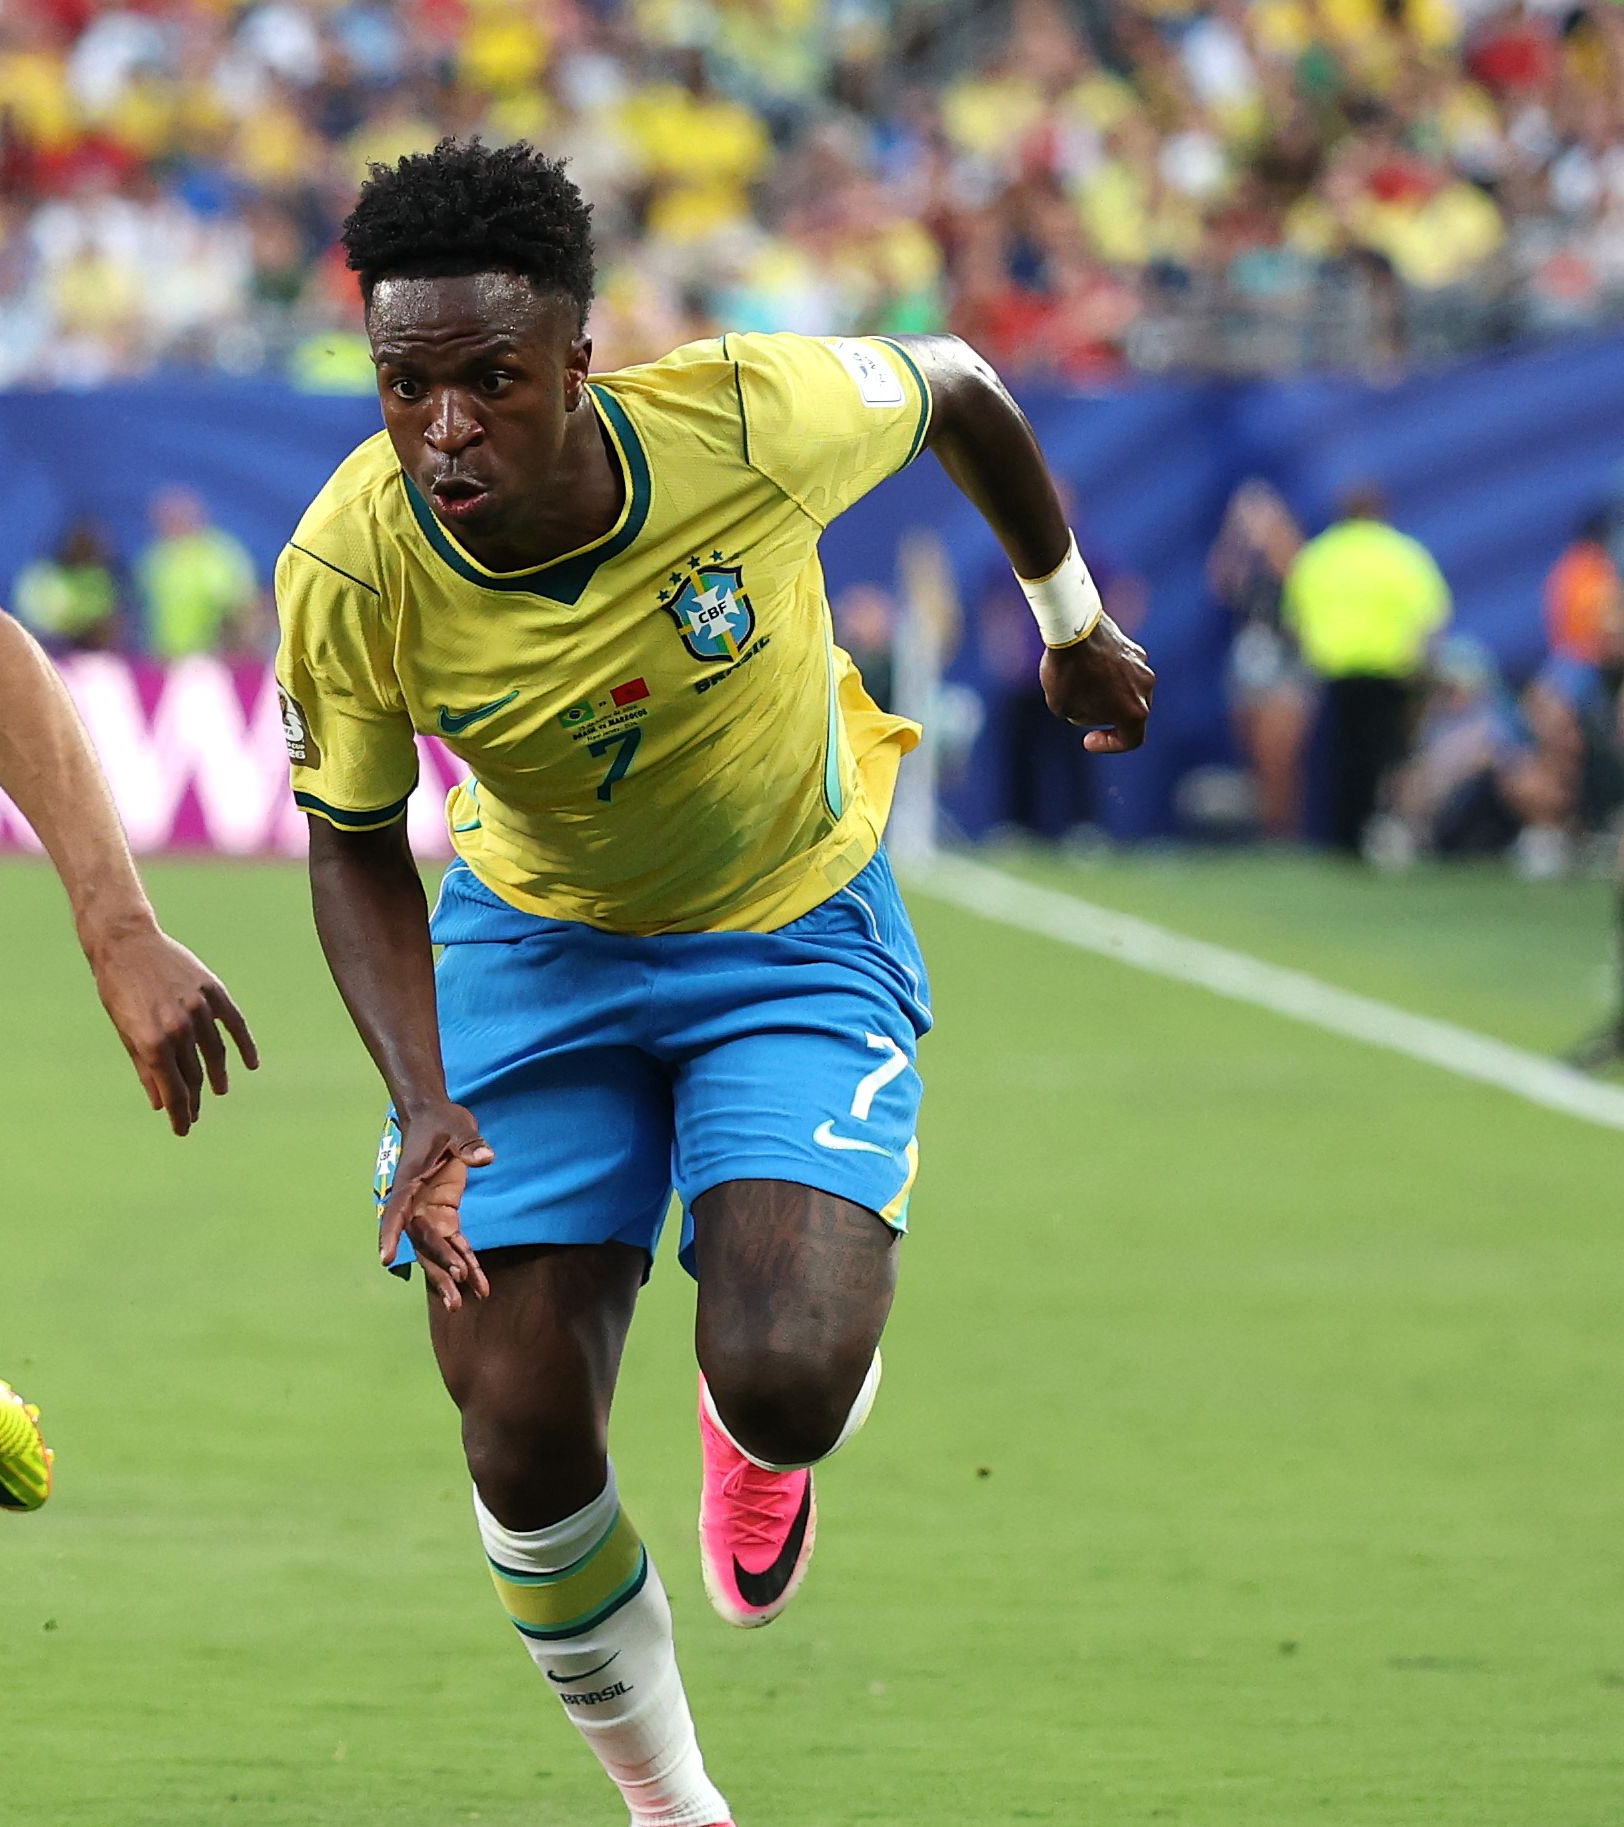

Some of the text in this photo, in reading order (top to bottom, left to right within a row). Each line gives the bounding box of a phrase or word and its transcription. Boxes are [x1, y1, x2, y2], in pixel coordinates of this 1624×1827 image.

[698, 601, 727, 624] CBF
[288, 749, 306, 759] 26
[587, 726, 641, 802] 7
[850, 1031, 909, 1121] 7
[560, 1681, 634, 1706] BRASIL
